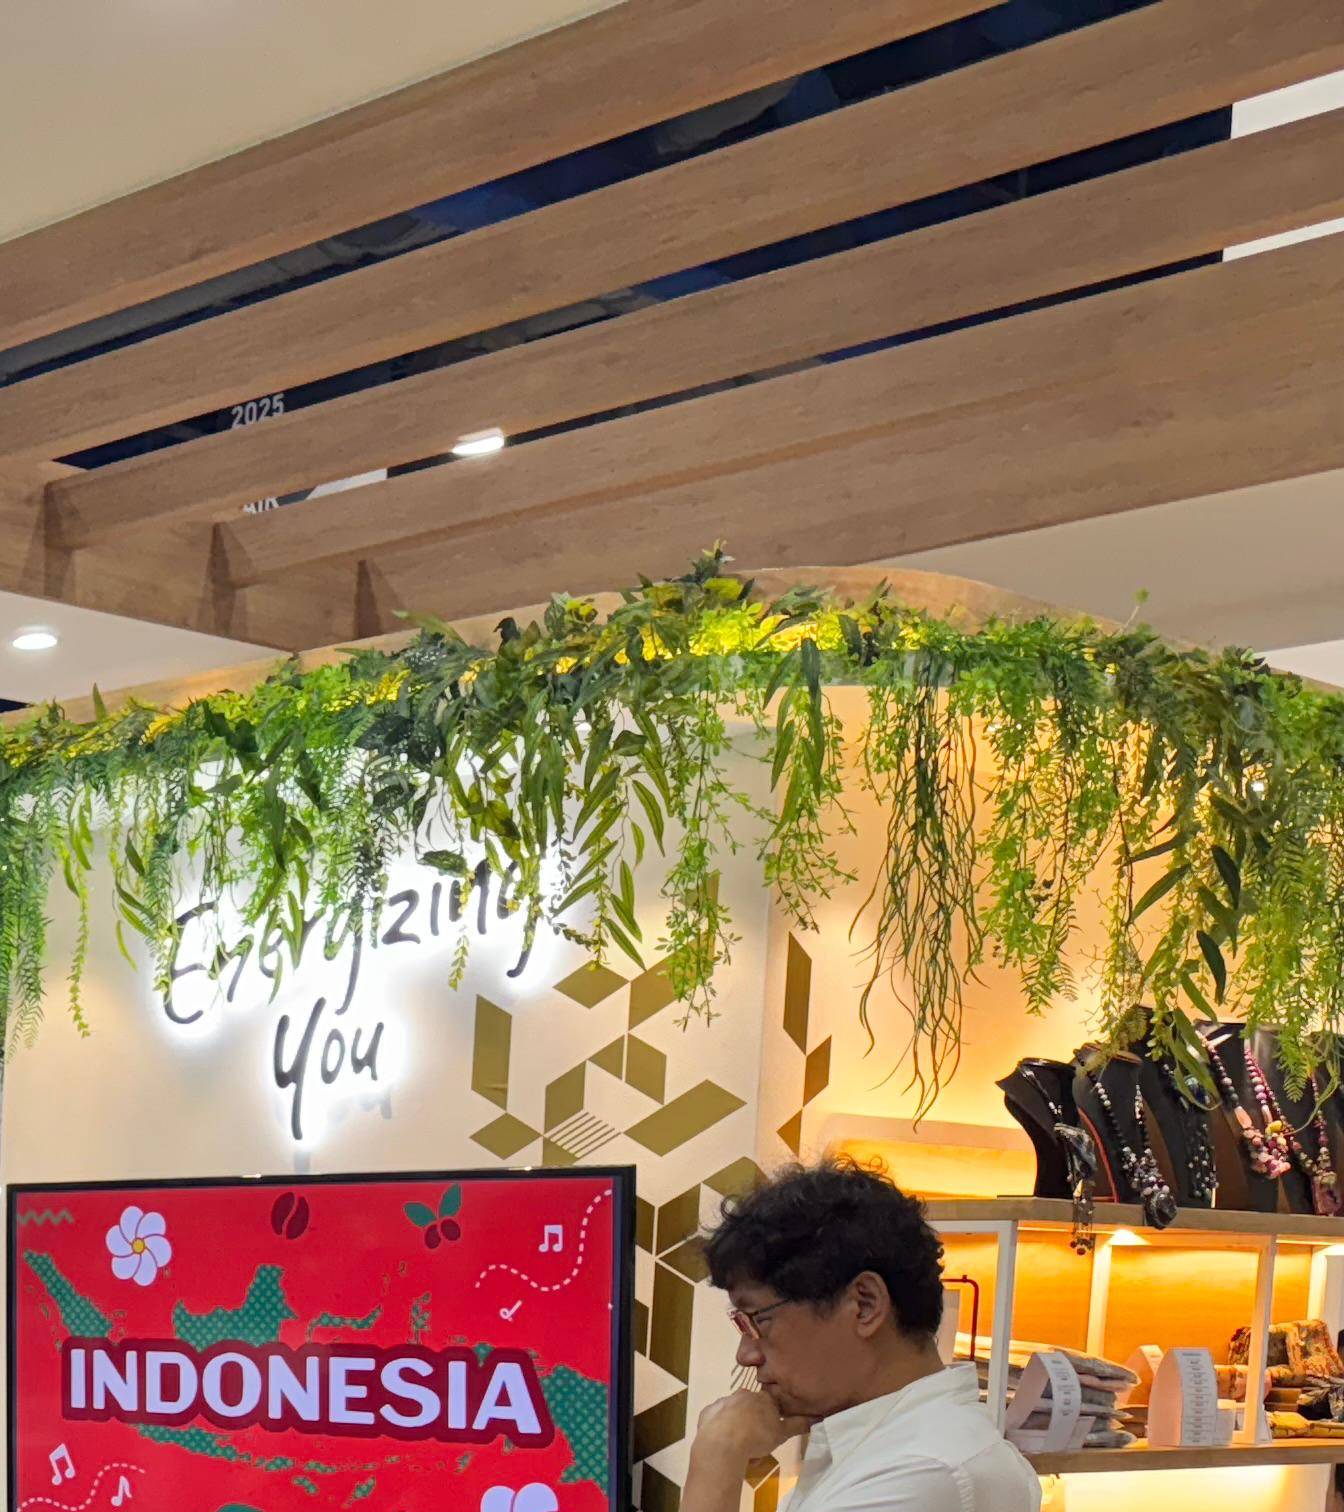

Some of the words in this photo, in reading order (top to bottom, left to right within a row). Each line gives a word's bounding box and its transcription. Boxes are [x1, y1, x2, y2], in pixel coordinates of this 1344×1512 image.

[231, 393, 285, 429] 2025
[274, 997, 385, 1140] You
[70, 1346, 543, 1435] INDONESIA
